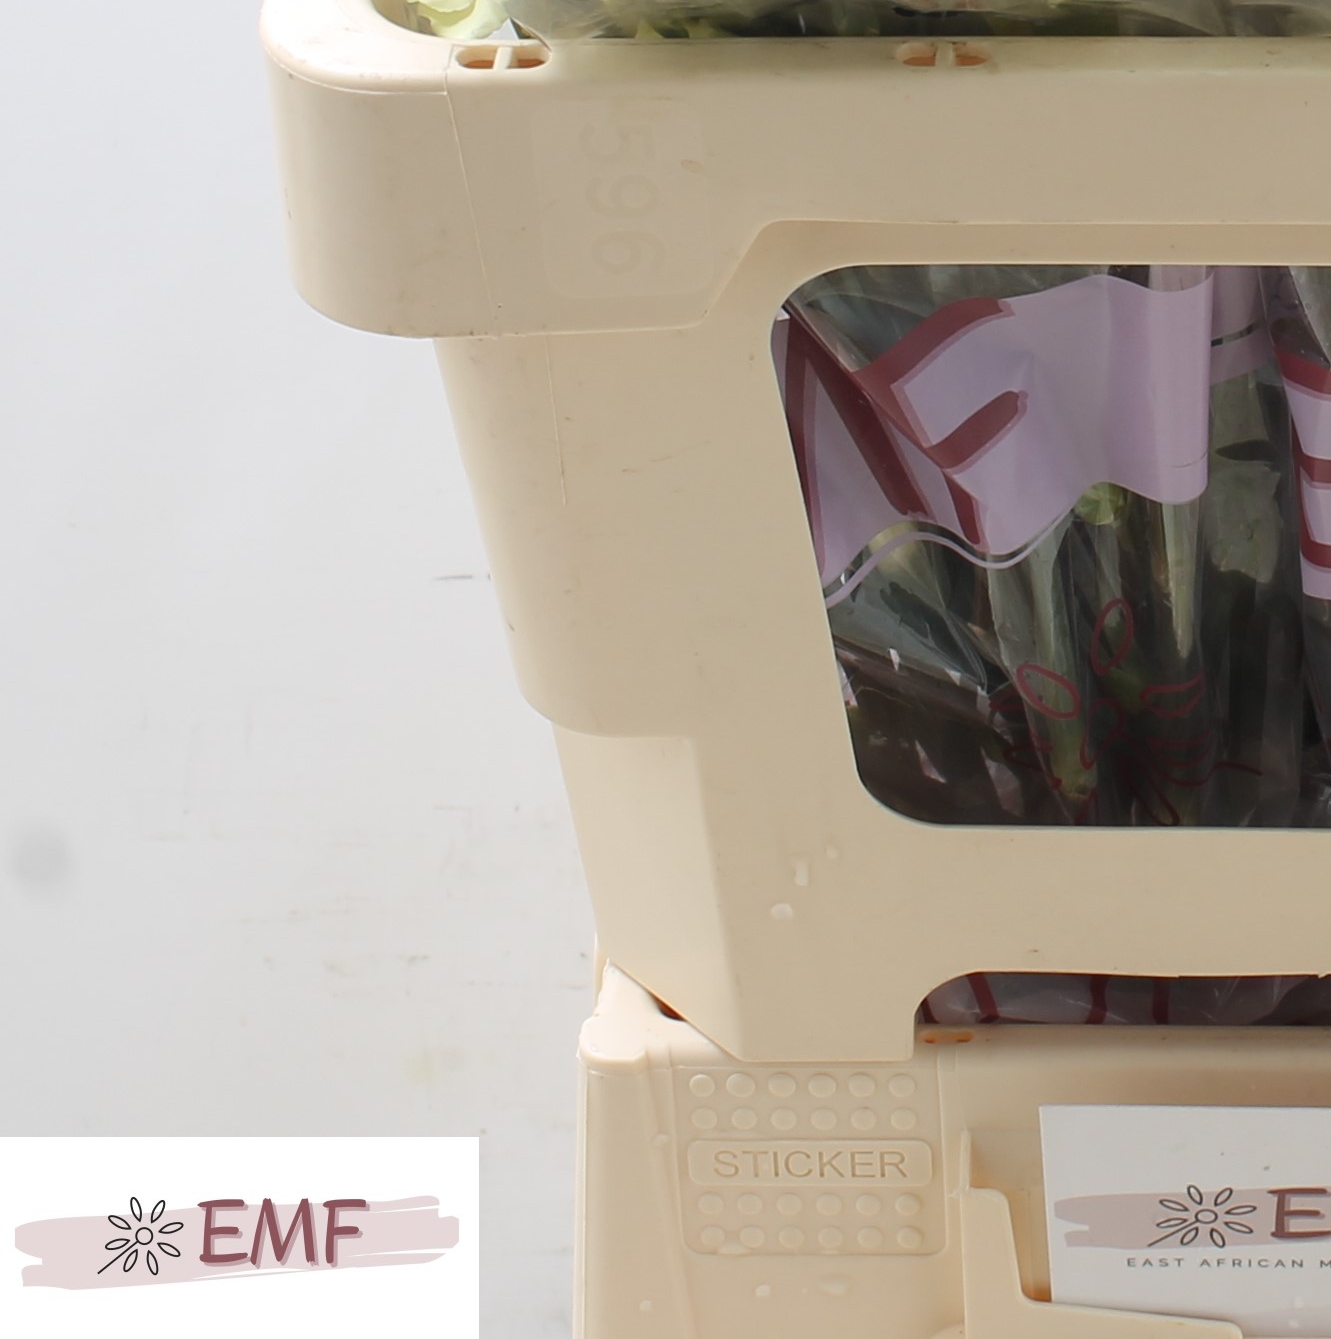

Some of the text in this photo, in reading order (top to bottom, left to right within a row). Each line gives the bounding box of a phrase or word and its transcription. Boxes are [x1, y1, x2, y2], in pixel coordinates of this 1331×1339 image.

[712, 1150, 908, 1179] STICKER
[1126, 1257, 1185, 1268] EAST
[1199, 1258, 1304, 1269] AFRICAN
